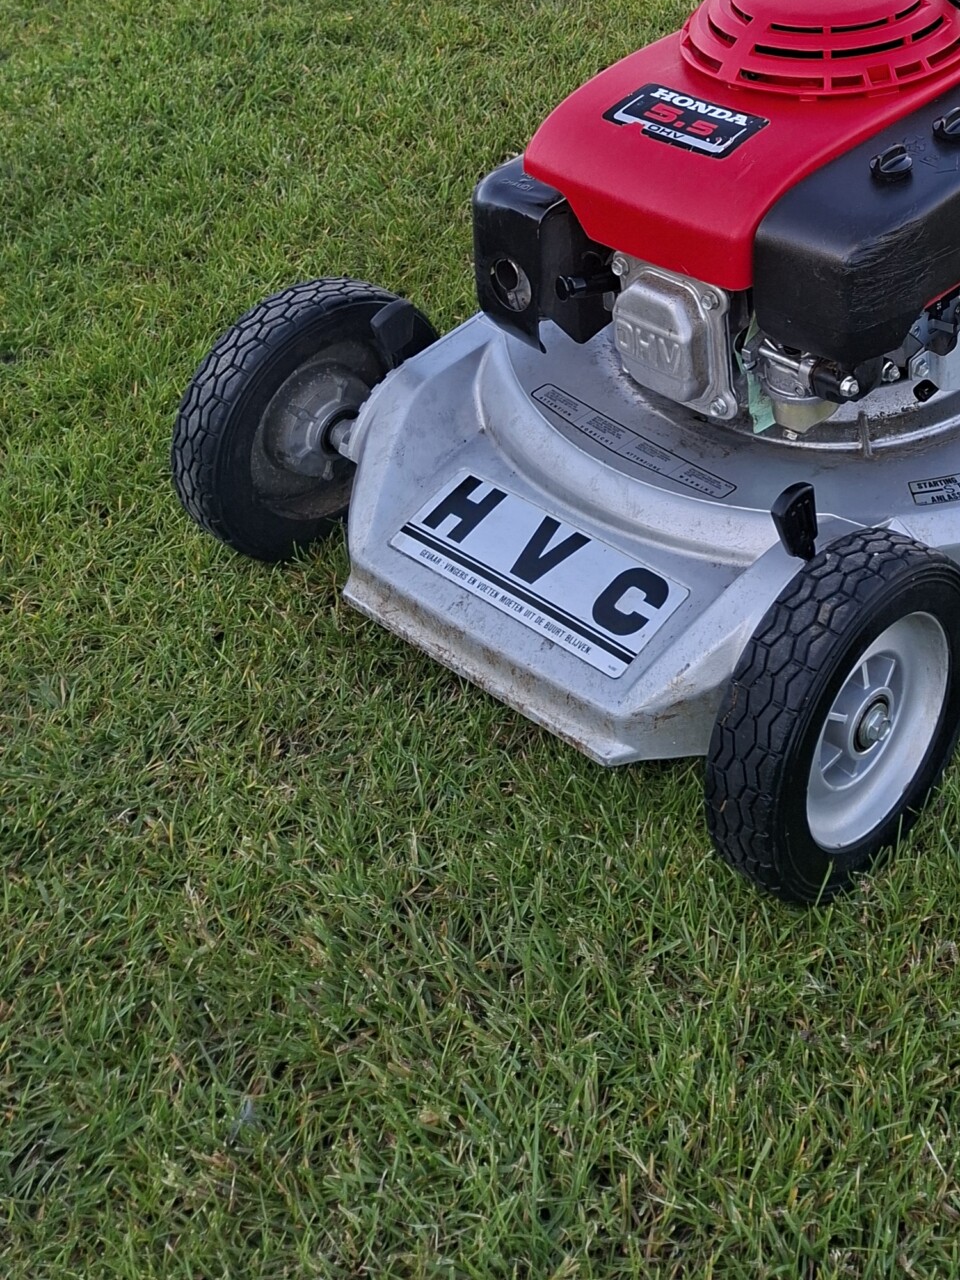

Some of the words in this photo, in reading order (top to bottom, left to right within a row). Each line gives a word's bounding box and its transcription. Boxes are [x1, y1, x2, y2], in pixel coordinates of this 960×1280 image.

[643, 103, 719, 137] 5.5
[650, 88, 748, 126] HONDA
[647, 124, 686, 139] OHV
[616, 321, 682, 375] OHV
[539, 396, 572, 417] ATTENTION
[916, 477, 958, 489] STARTING
[443, 562, 469, 580] VINGERS
[467, 576, 478, 585] EN
[476, 581, 500, 599] VOETEN
[498, 595, 524, 614] MOETEN
[523, 609, 536, 620] UIT
[534, 615, 544, 626] DE
[543, 621, 566, 638] BUURT
